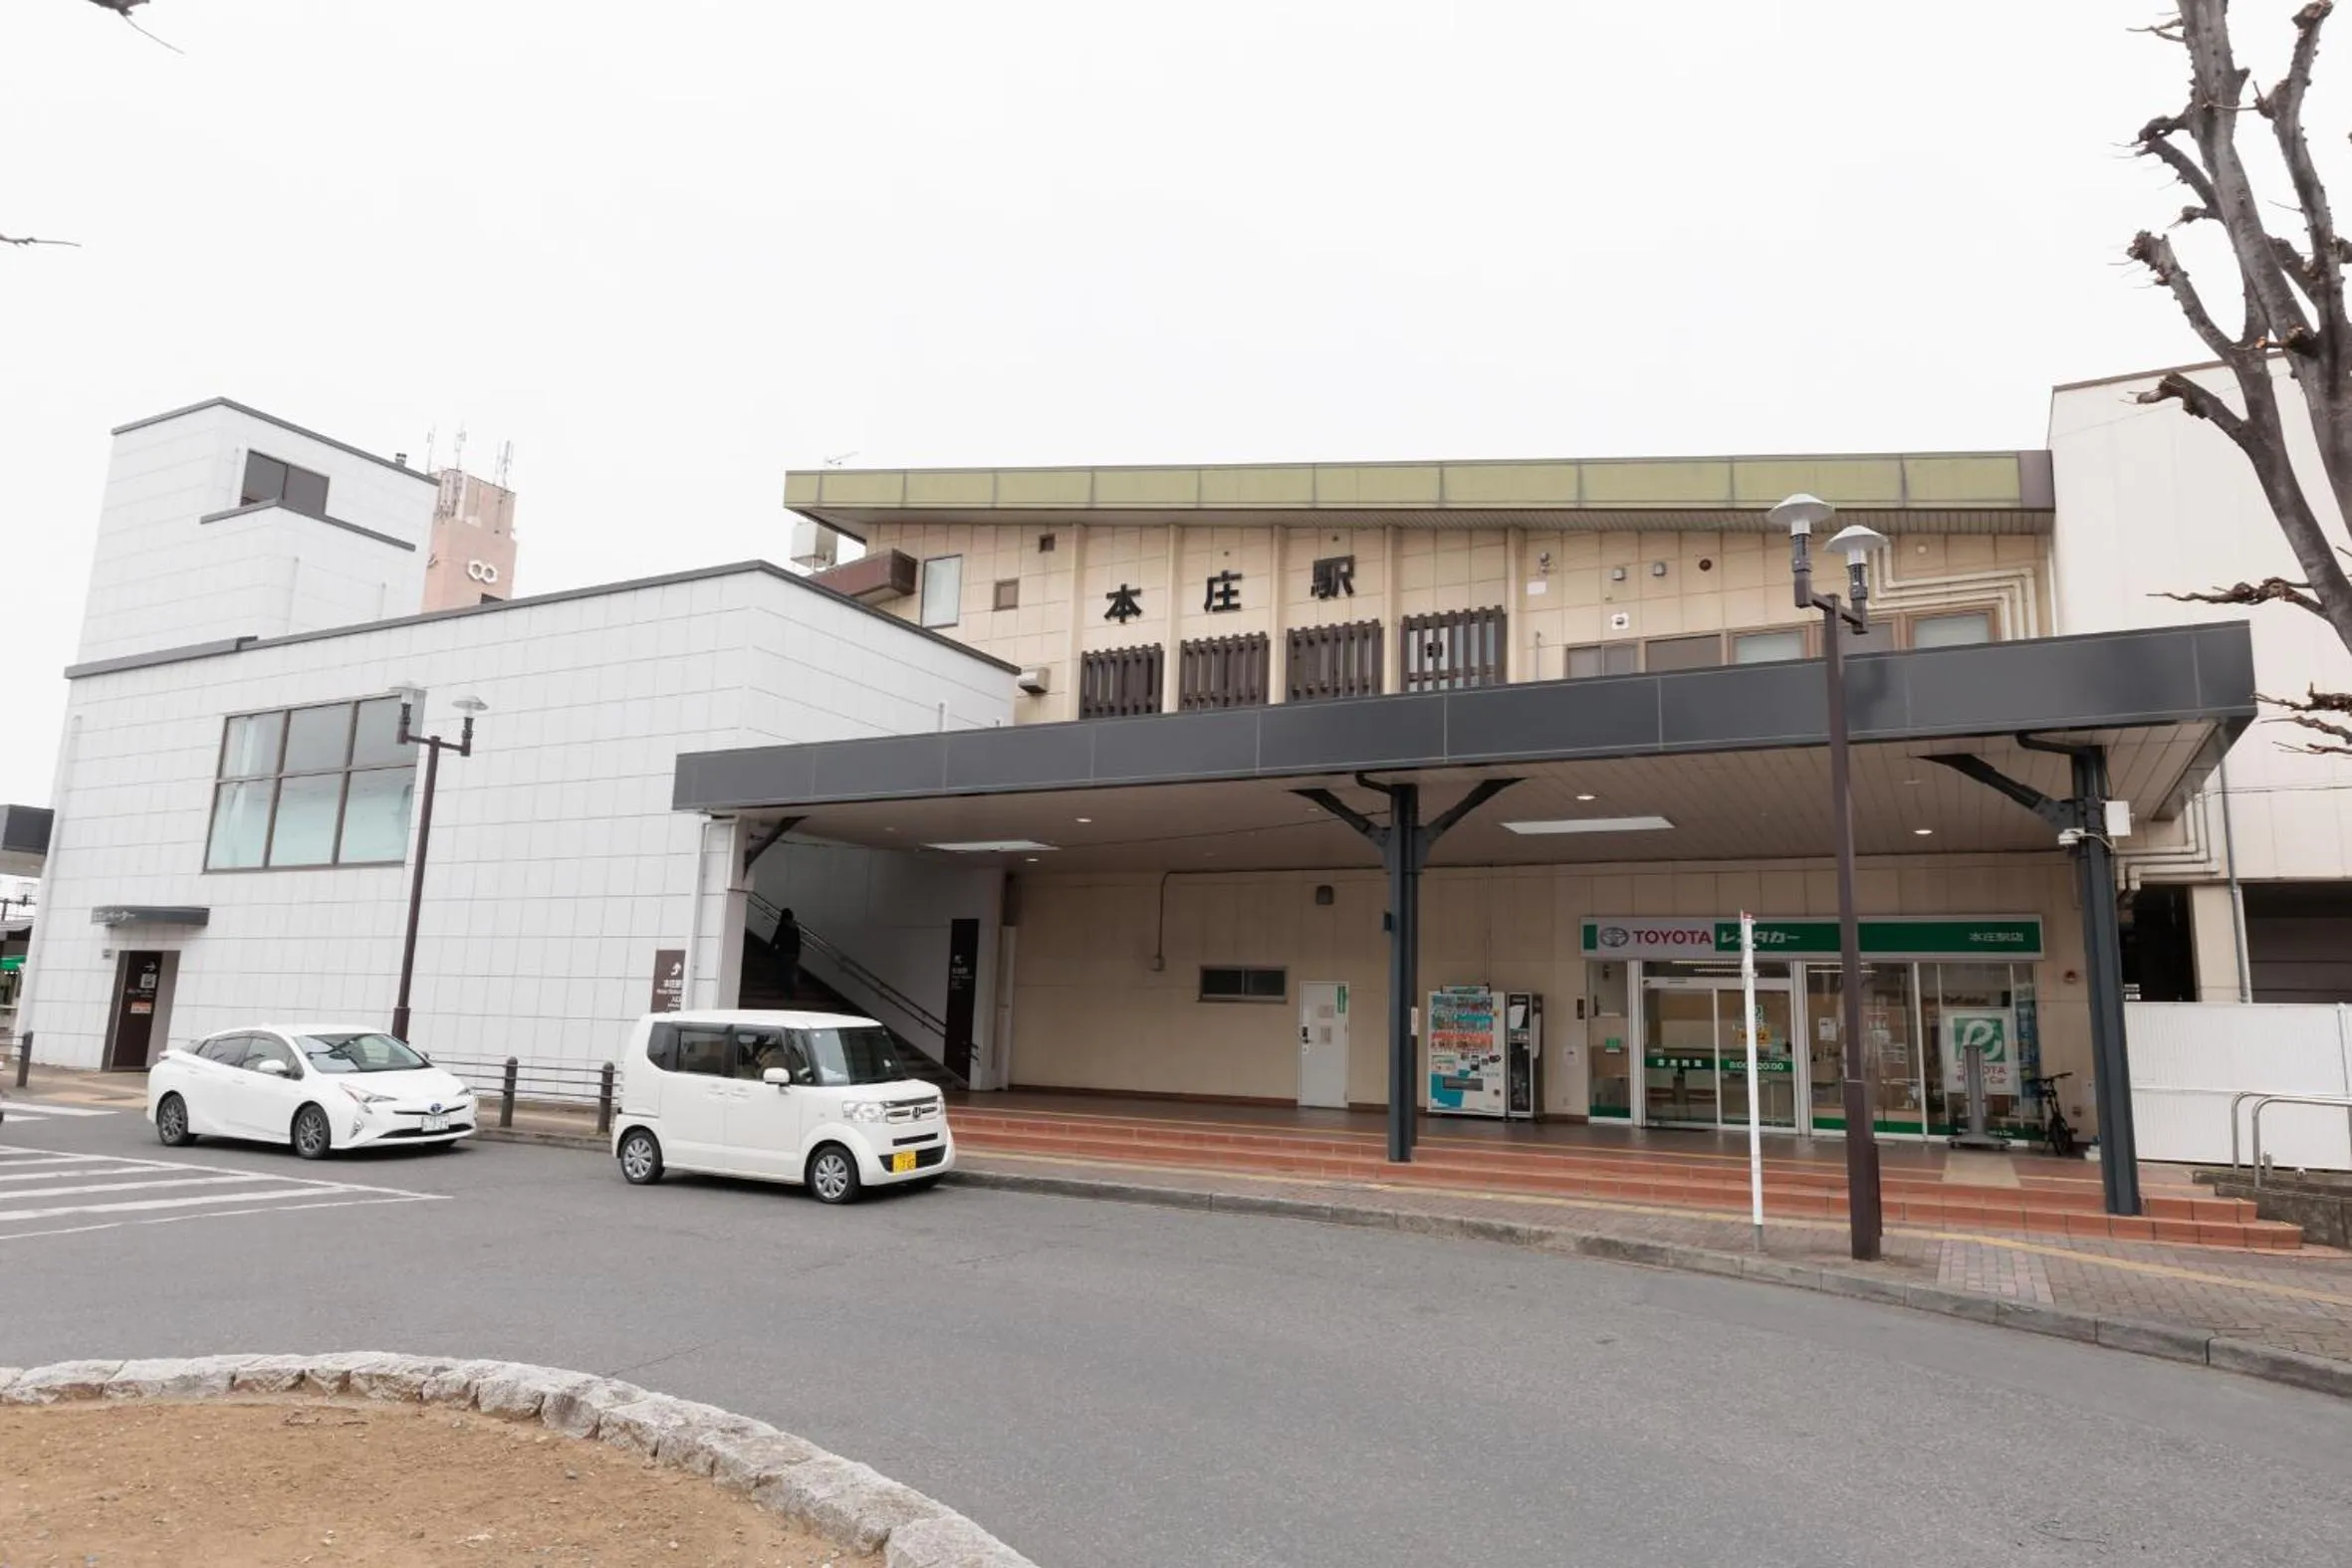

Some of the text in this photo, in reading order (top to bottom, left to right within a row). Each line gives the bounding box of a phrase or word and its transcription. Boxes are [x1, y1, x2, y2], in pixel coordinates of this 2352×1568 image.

[1103, 555, 1355, 623] 本庄駅
[1633, 930, 1800, 945] TOYOTA レタカー
